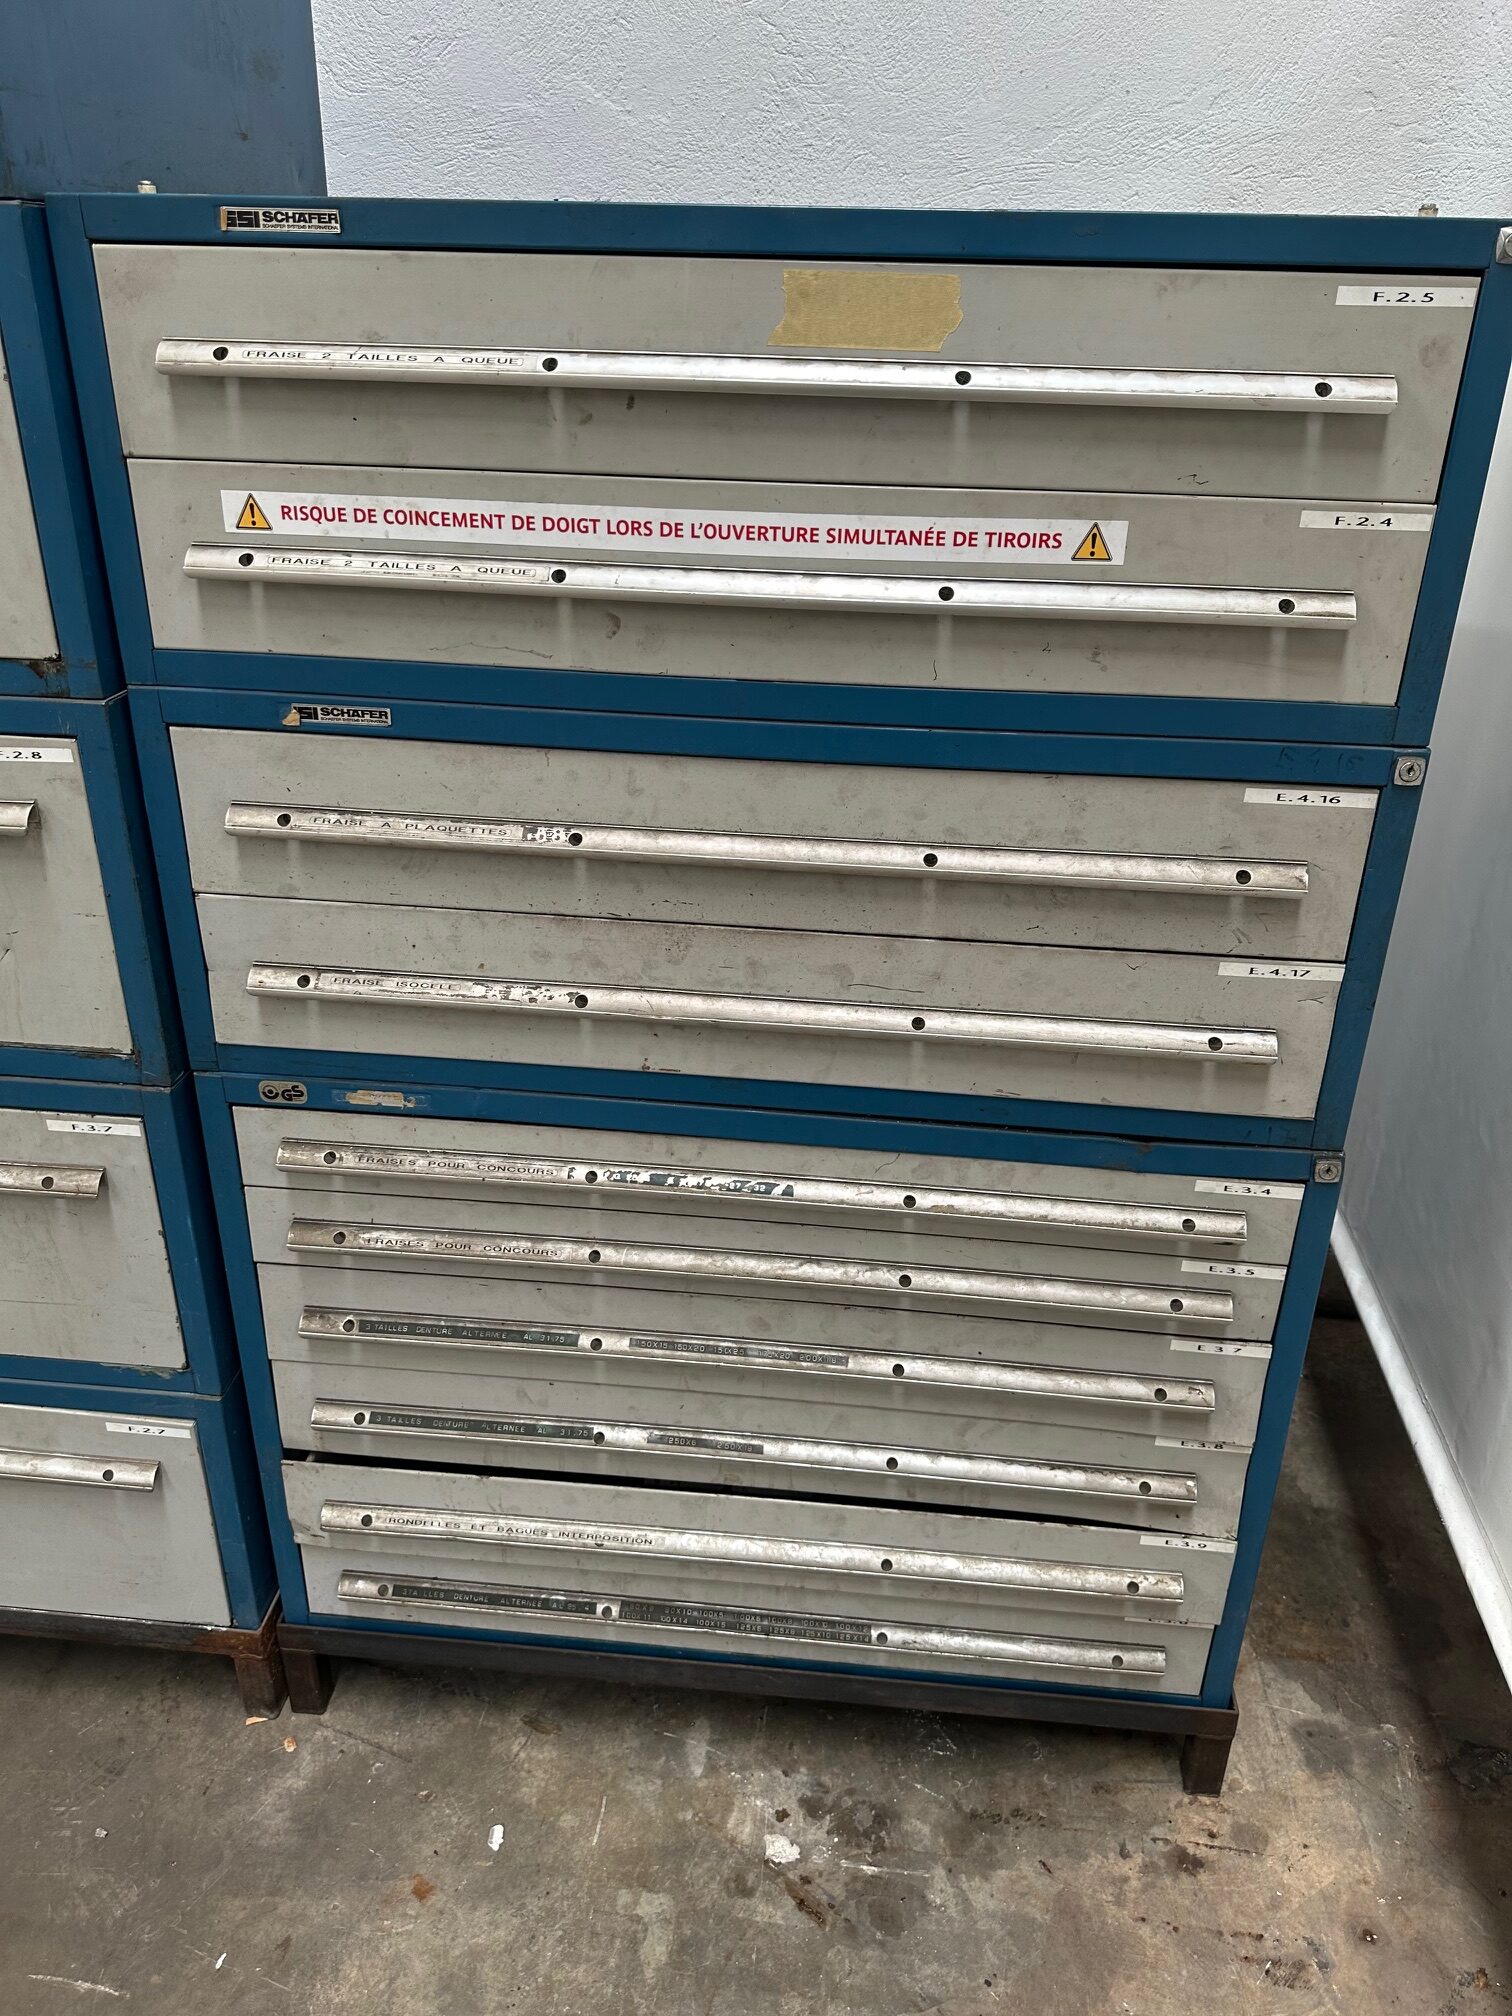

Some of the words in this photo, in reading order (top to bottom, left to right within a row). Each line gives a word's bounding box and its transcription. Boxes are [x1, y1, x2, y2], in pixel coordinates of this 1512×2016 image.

[1373, 292, 1434, 303] F.2.5
[247, 351, 306, 359] FRAISE
[349, 353, 417, 361] TAILLES
[461, 357, 519, 365] QUEUE
[280, 505, 347, 523] RISQUE
[354, 508, 377, 523] DE
[383, 509, 505, 529] COINCEMENT
[512, 515, 535, 531] DE
[542, 516, 600, 534] DOIGT
[607, 519, 653, 536] LORS
[660, 521, 684, 538] DE
[691, 522, 819, 543] L'OUVERTURE
[826, 526, 946, 547] SIMULTANÉE
[953, 531, 978, 547] DE
[985, 531, 1062, 549] TIROIRS
[1335, 516, 1393, 527] F.2.4
[272, 557, 330, 565] FRAISE
[369, 561, 436, 570] TAILLES
[477, 567, 532, 576] QUEUE
[0, 751, 42, 760] .2.8
[1276, 793, 1341, 804] E.4.16
[314, 817, 367, 826] FRAISE
[405, 823, 507, 836] PLAQUETTES
[1249, 967, 1310, 977] E.4.17
[333, 977, 381, 986] FRAISE
[72, 1124, 112, 1132] F.3.7
[358, 1156, 416, 1166] FRAISES
[428, 1160, 465, 1169] POUR
[477, 1164, 554, 1175] CONCOURS
[1224, 1185, 1271, 1195] E.3.4
[366, 1238, 424, 1247] FRAISES
[435, 1242, 472, 1251] POUR
[483, 1245, 558, 1256] CONCOURS
[1209, 1265, 1255, 1275] E.3.5
[375, 1323, 408, 1332] TAILLES
[416, 1326, 452, 1335] DENTURE
[462, 1329, 507, 1339] ALTERNEE
[674, 1343, 705, 1352] 150X20
[128, 1426, 165, 1434] F.2.7
[433, 1419, 469, 1429] DENTURE
[481, 1422, 526, 1432] ALTERNEE
[560, 1429, 588, 1437] 31.75
[1181, 1440, 1224, 1449] E.3.8
[388, 1517, 460, 1528] RONDELLES
[497, 1526, 547, 1536] BAGUES
[559, 1531, 652, 1544] INTERPOSITION
[454, 1593, 489, 1603] DENTURE
[501, 1598, 542, 1608] ALTERNEE
